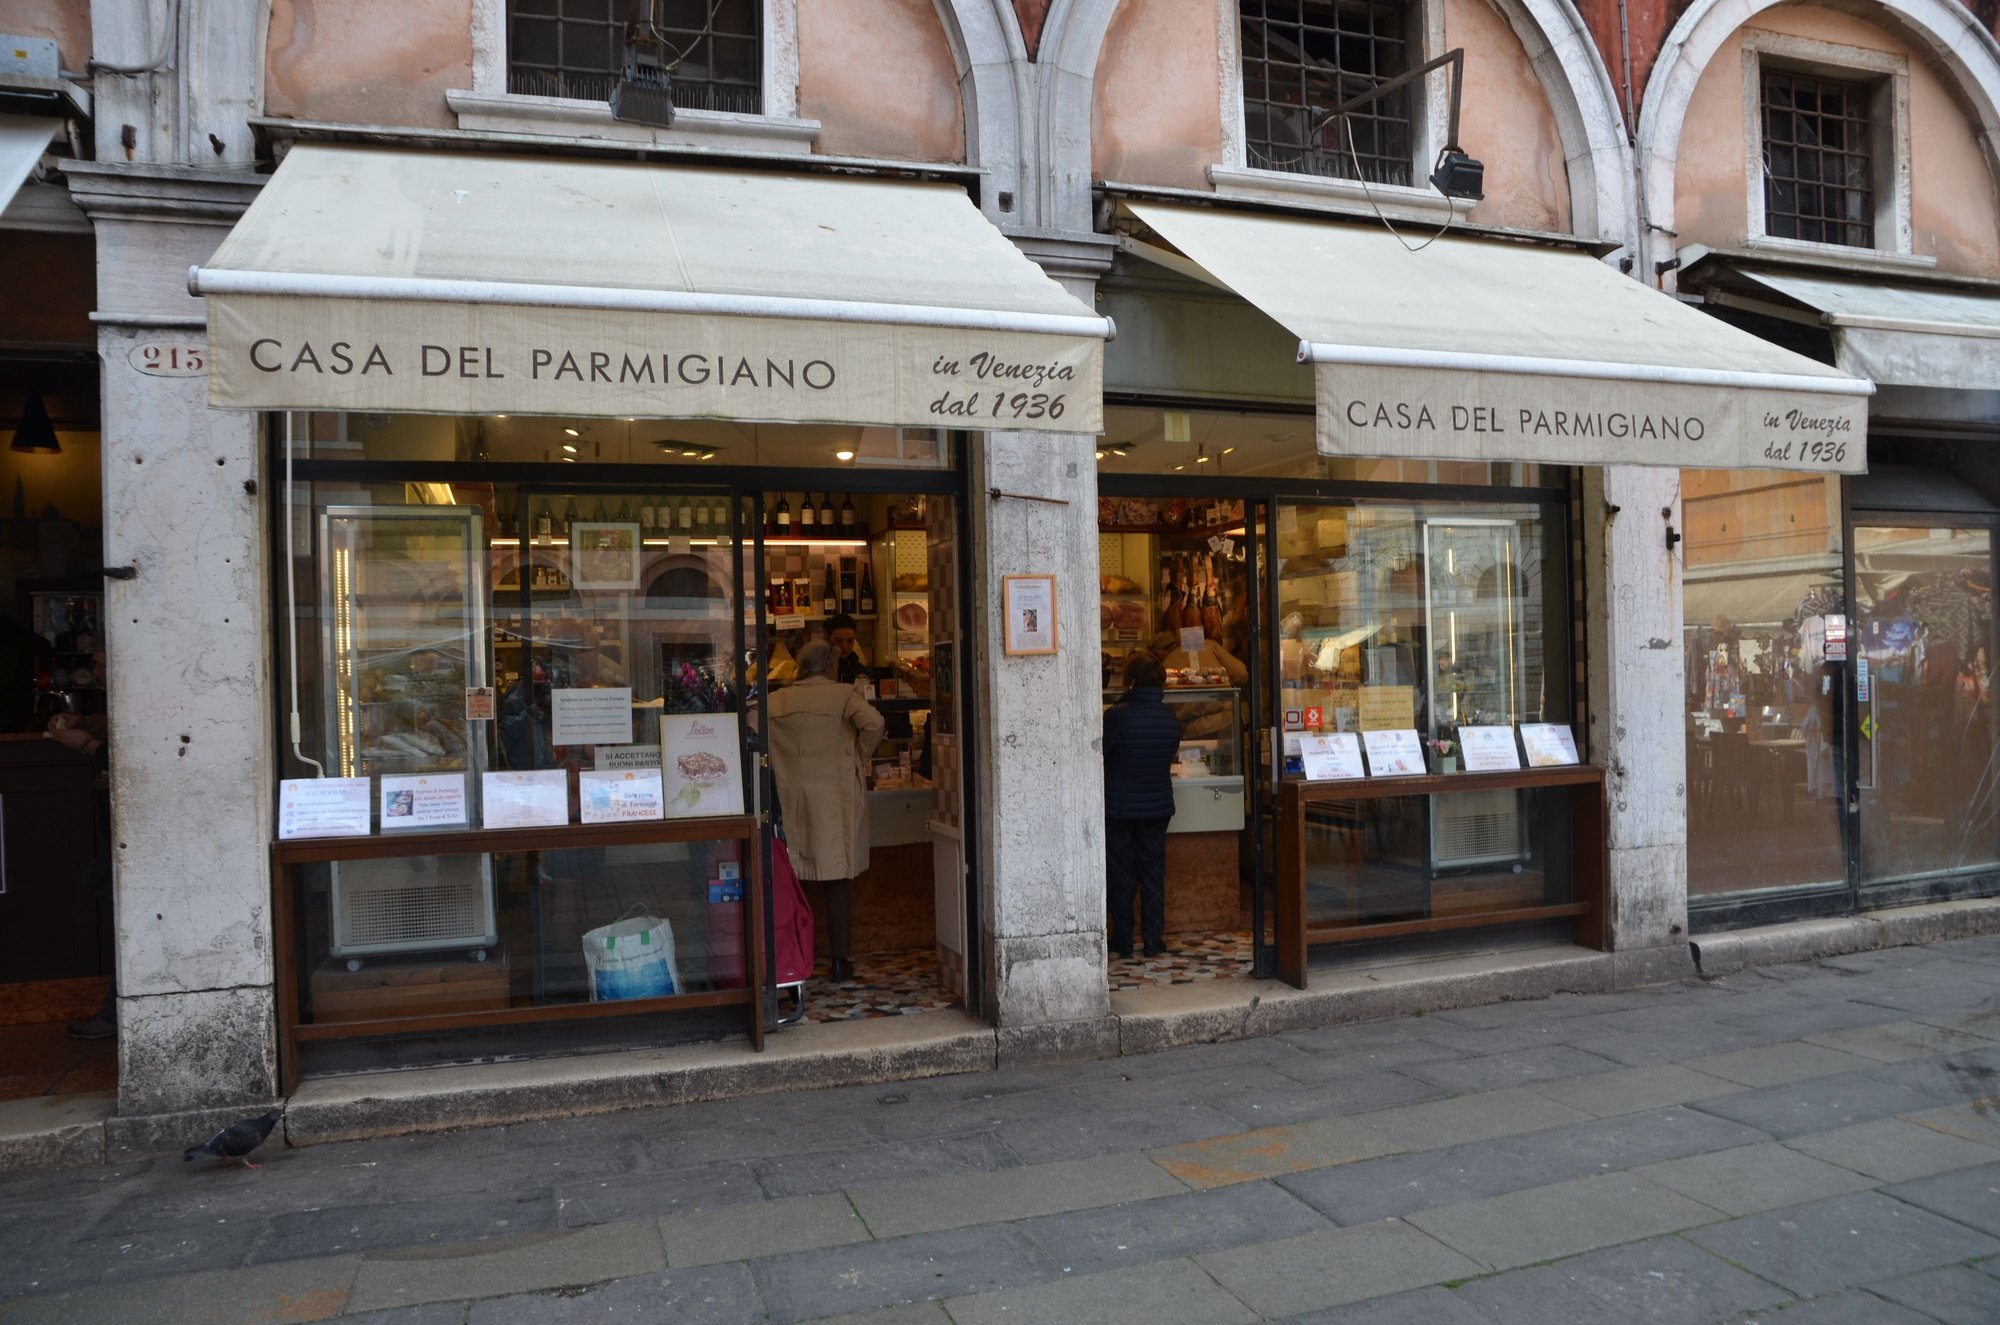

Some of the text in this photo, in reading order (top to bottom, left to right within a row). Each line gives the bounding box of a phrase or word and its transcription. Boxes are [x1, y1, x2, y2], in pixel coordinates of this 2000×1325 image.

[249, 337, 836, 390] CASA DEL PARMIGIANO
[932, 351, 1076, 388] in Venezia
[930, 391, 1067, 420] dal 1936
[1346, 400, 1705, 441] CASA DEL PARMIGIANO
[1763, 408, 1852, 438] in Venezia
[1764, 440, 1847, 463] dal 1936
[614, 752, 661, 760] ACCETTANO
[622, 809, 657, 817] FRANCESI
